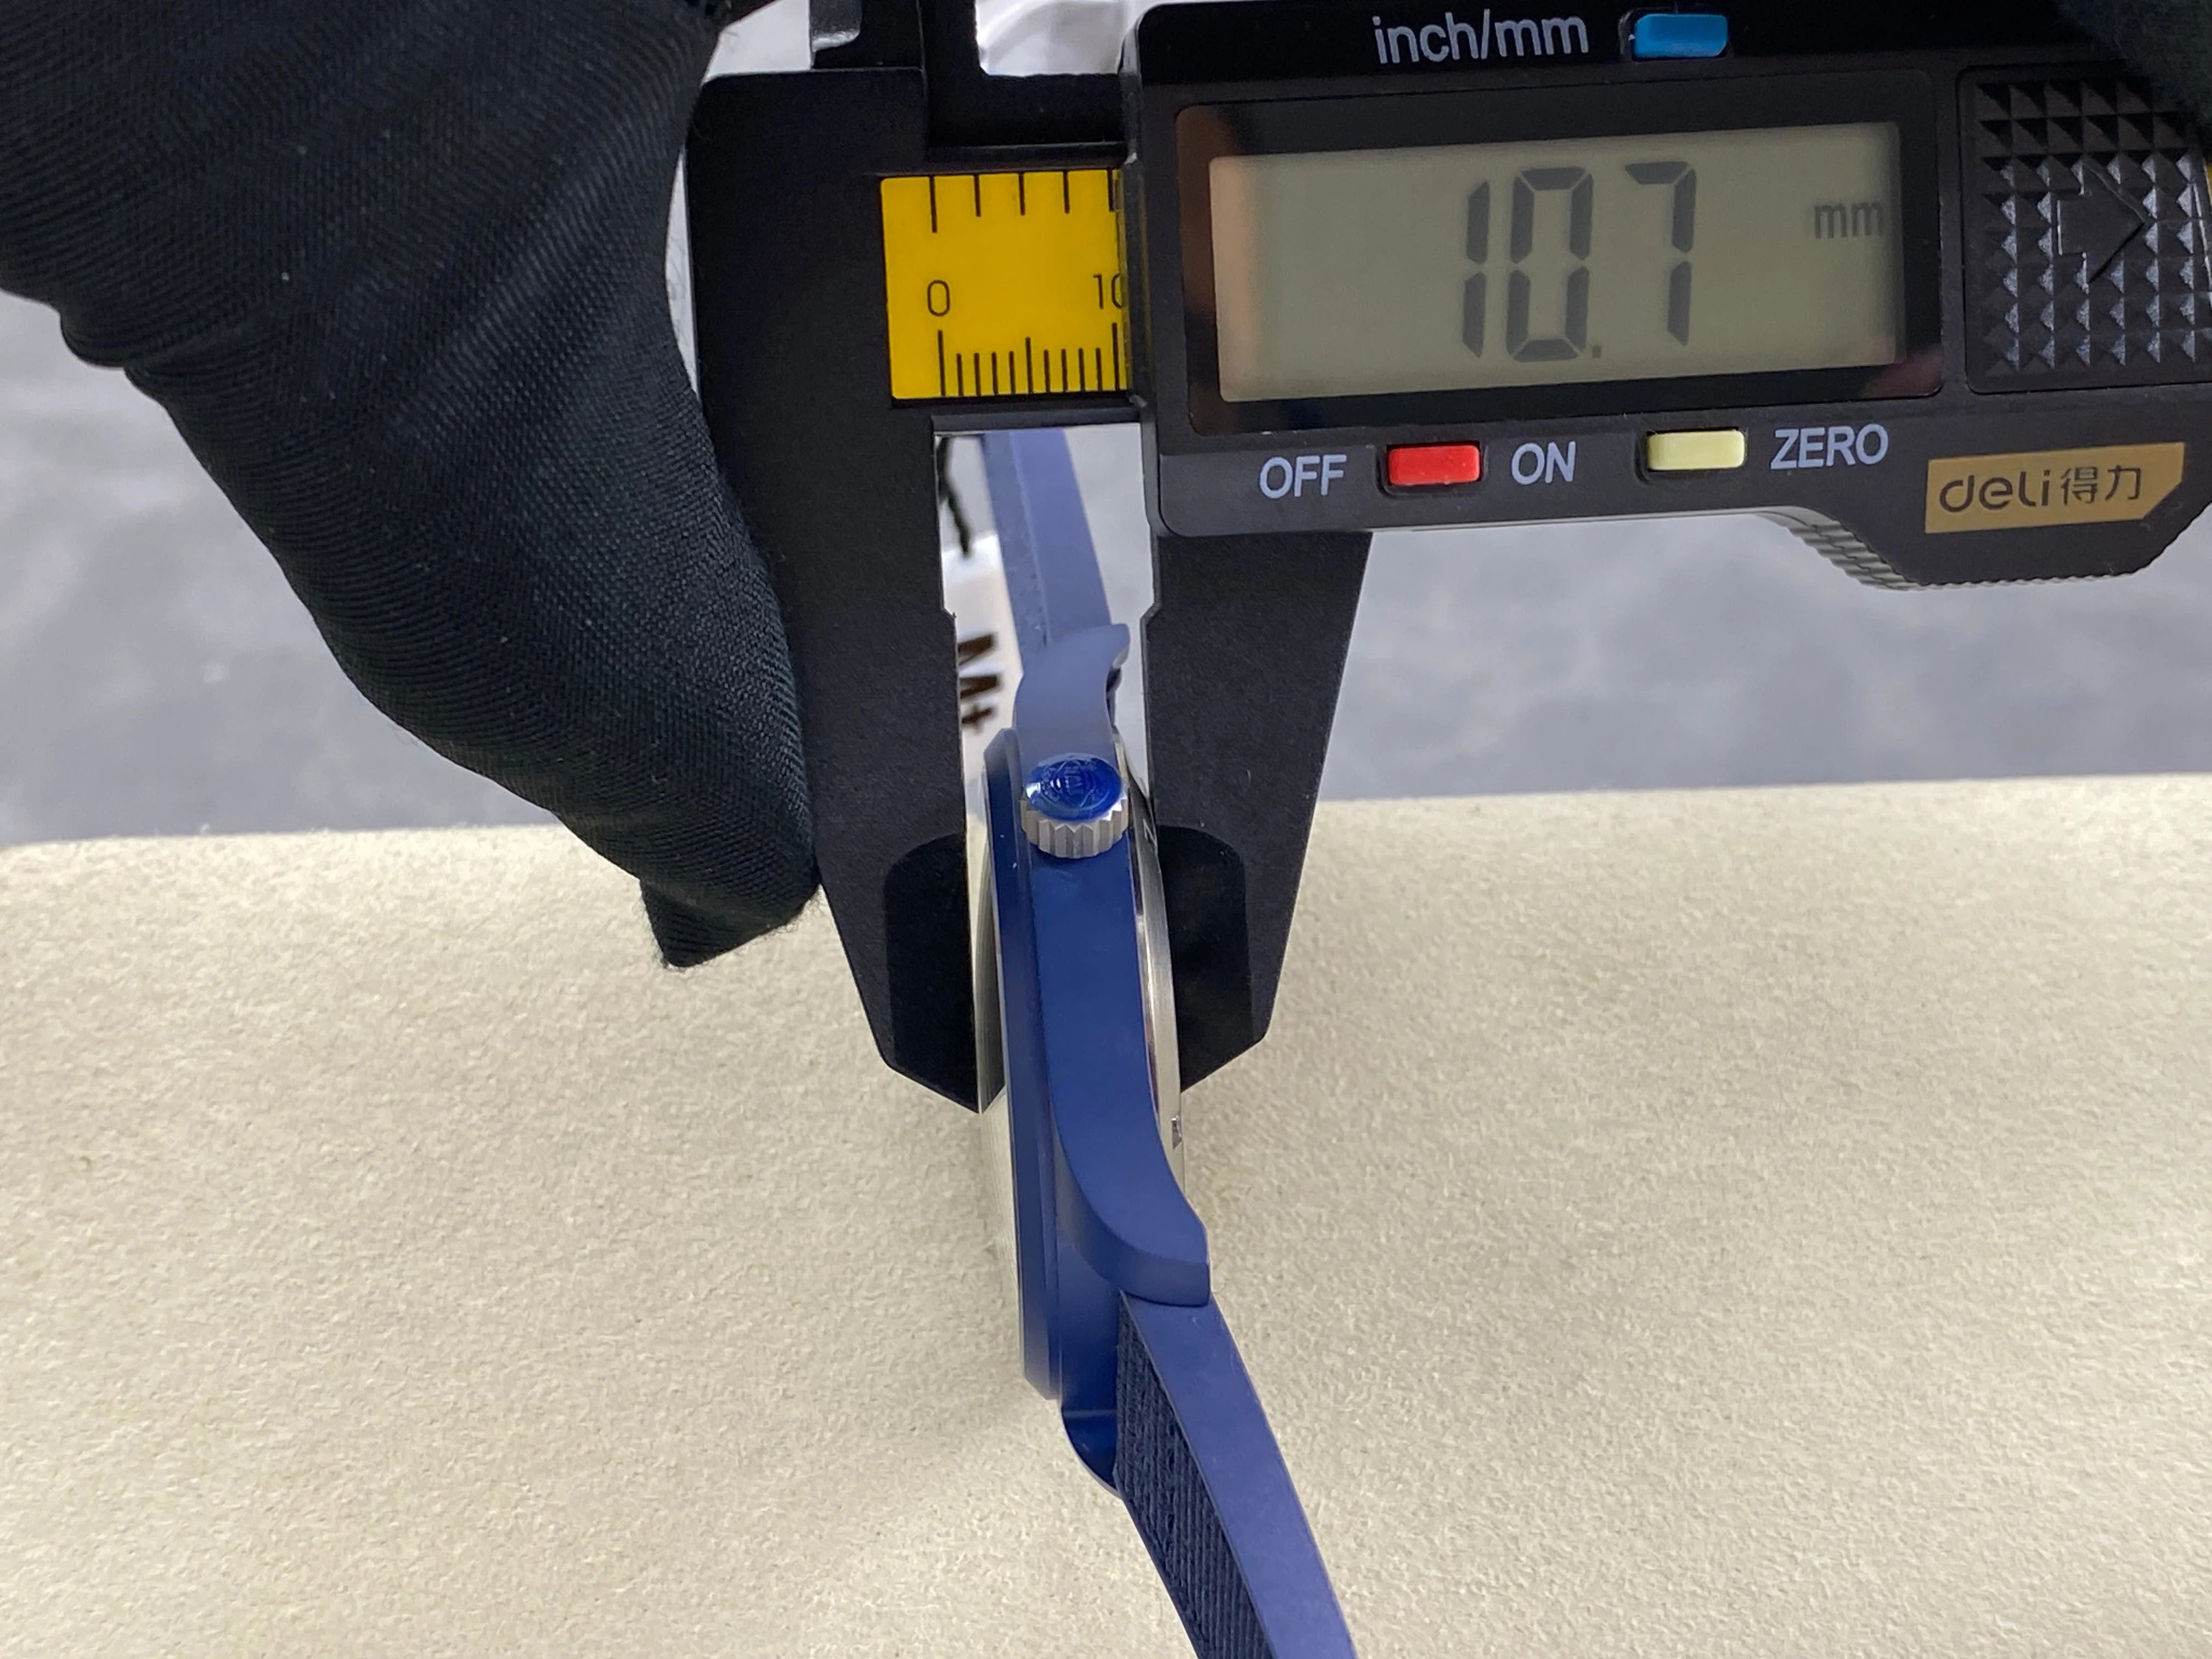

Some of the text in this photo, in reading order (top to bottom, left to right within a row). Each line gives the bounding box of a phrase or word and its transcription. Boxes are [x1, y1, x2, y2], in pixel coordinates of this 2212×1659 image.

[1372, 9, 1589, 64] inch/mm
[1462, 160, 1883, 363] 10.7 mm
[927, 279, 950, 317] 0
[1511, 441, 1577, 487] ON
[1770, 424, 1889, 471] ZERO
[1259, 453, 1347, 499] OFF
